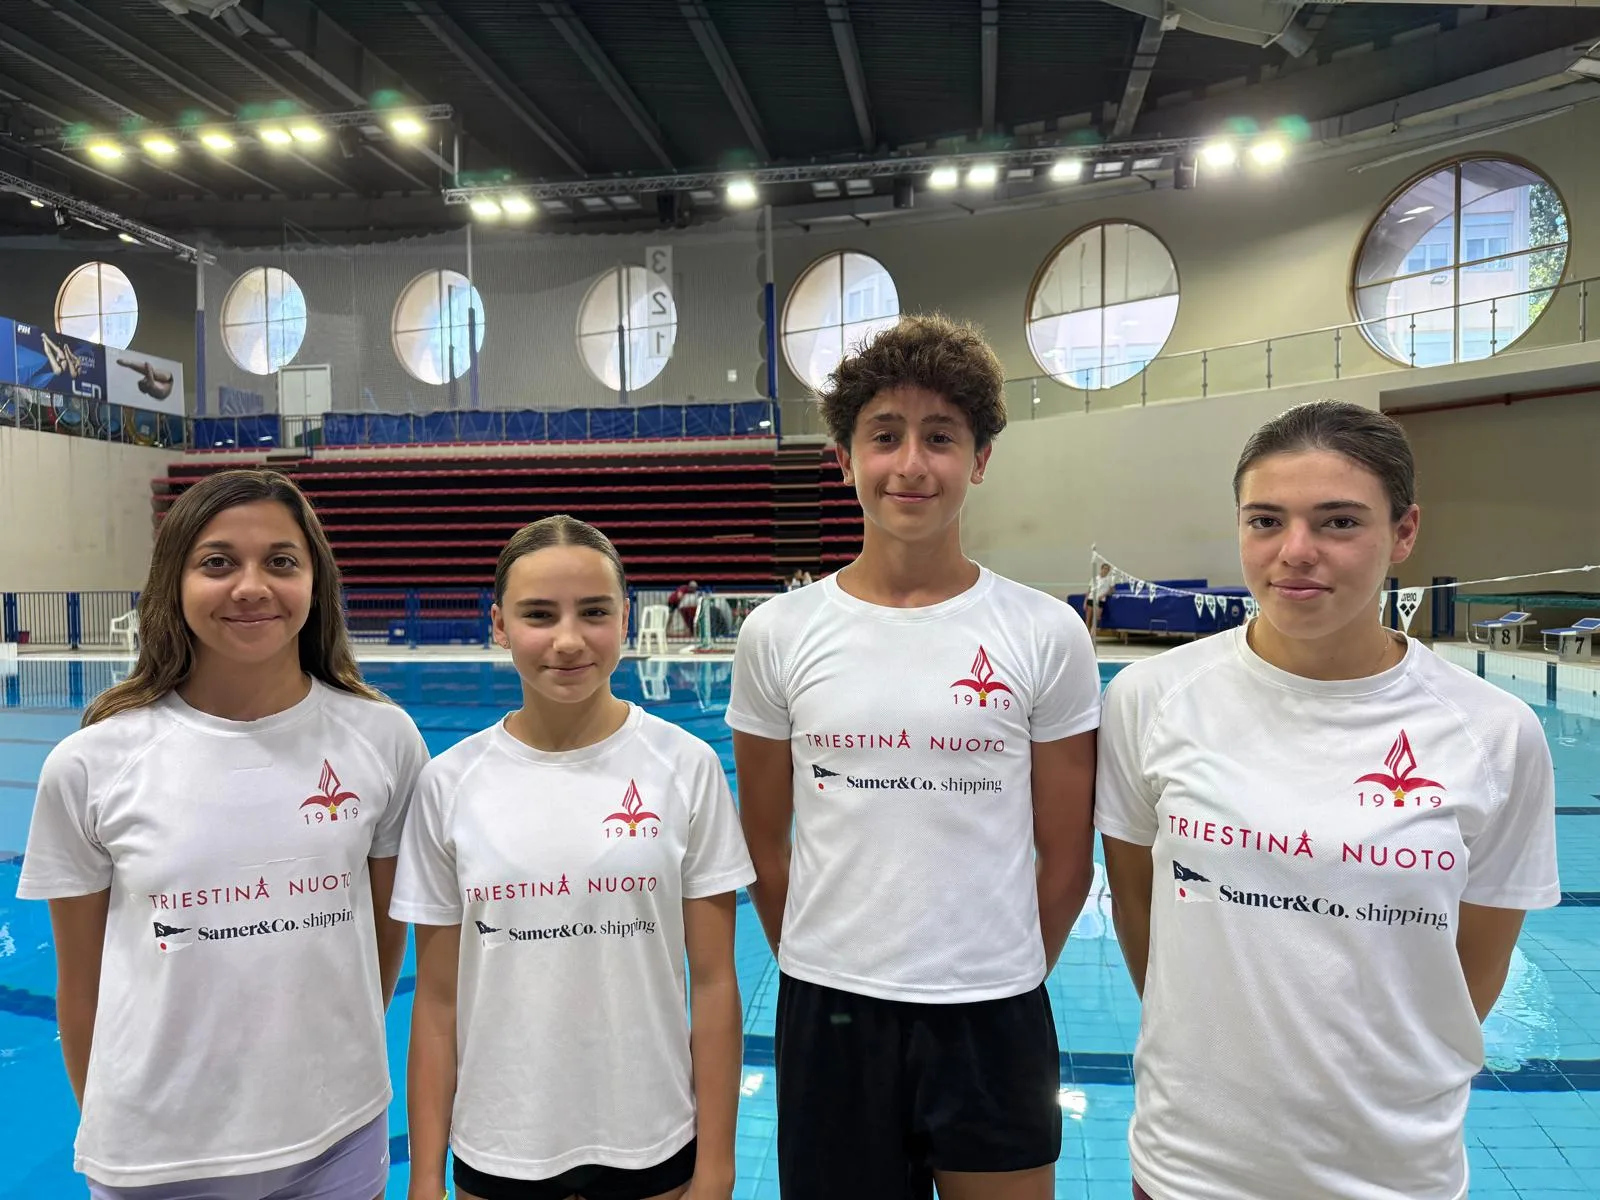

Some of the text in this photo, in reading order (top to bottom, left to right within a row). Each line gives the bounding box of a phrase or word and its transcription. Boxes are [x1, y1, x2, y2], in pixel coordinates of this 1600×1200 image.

[1502, 628, 1511, 645] 8
[1575, 636, 1585, 654] 7
[806, 731, 1005, 753] TRIESTINA NUOTO
[846, 775, 1003, 795] Samer&Co. shipping
[1168, 815, 1456, 872] TRIESTINA NUOTO
[149, 880, 270, 909] TRIESTINA
[466, 876, 657, 903] TRIESTINA NUOTO
[1219, 884, 1448, 931] Samer&Co. shipping
[197, 908, 355, 941] Samer&Co. shippin
[508, 917, 657, 941] Samer&Co. shipping
